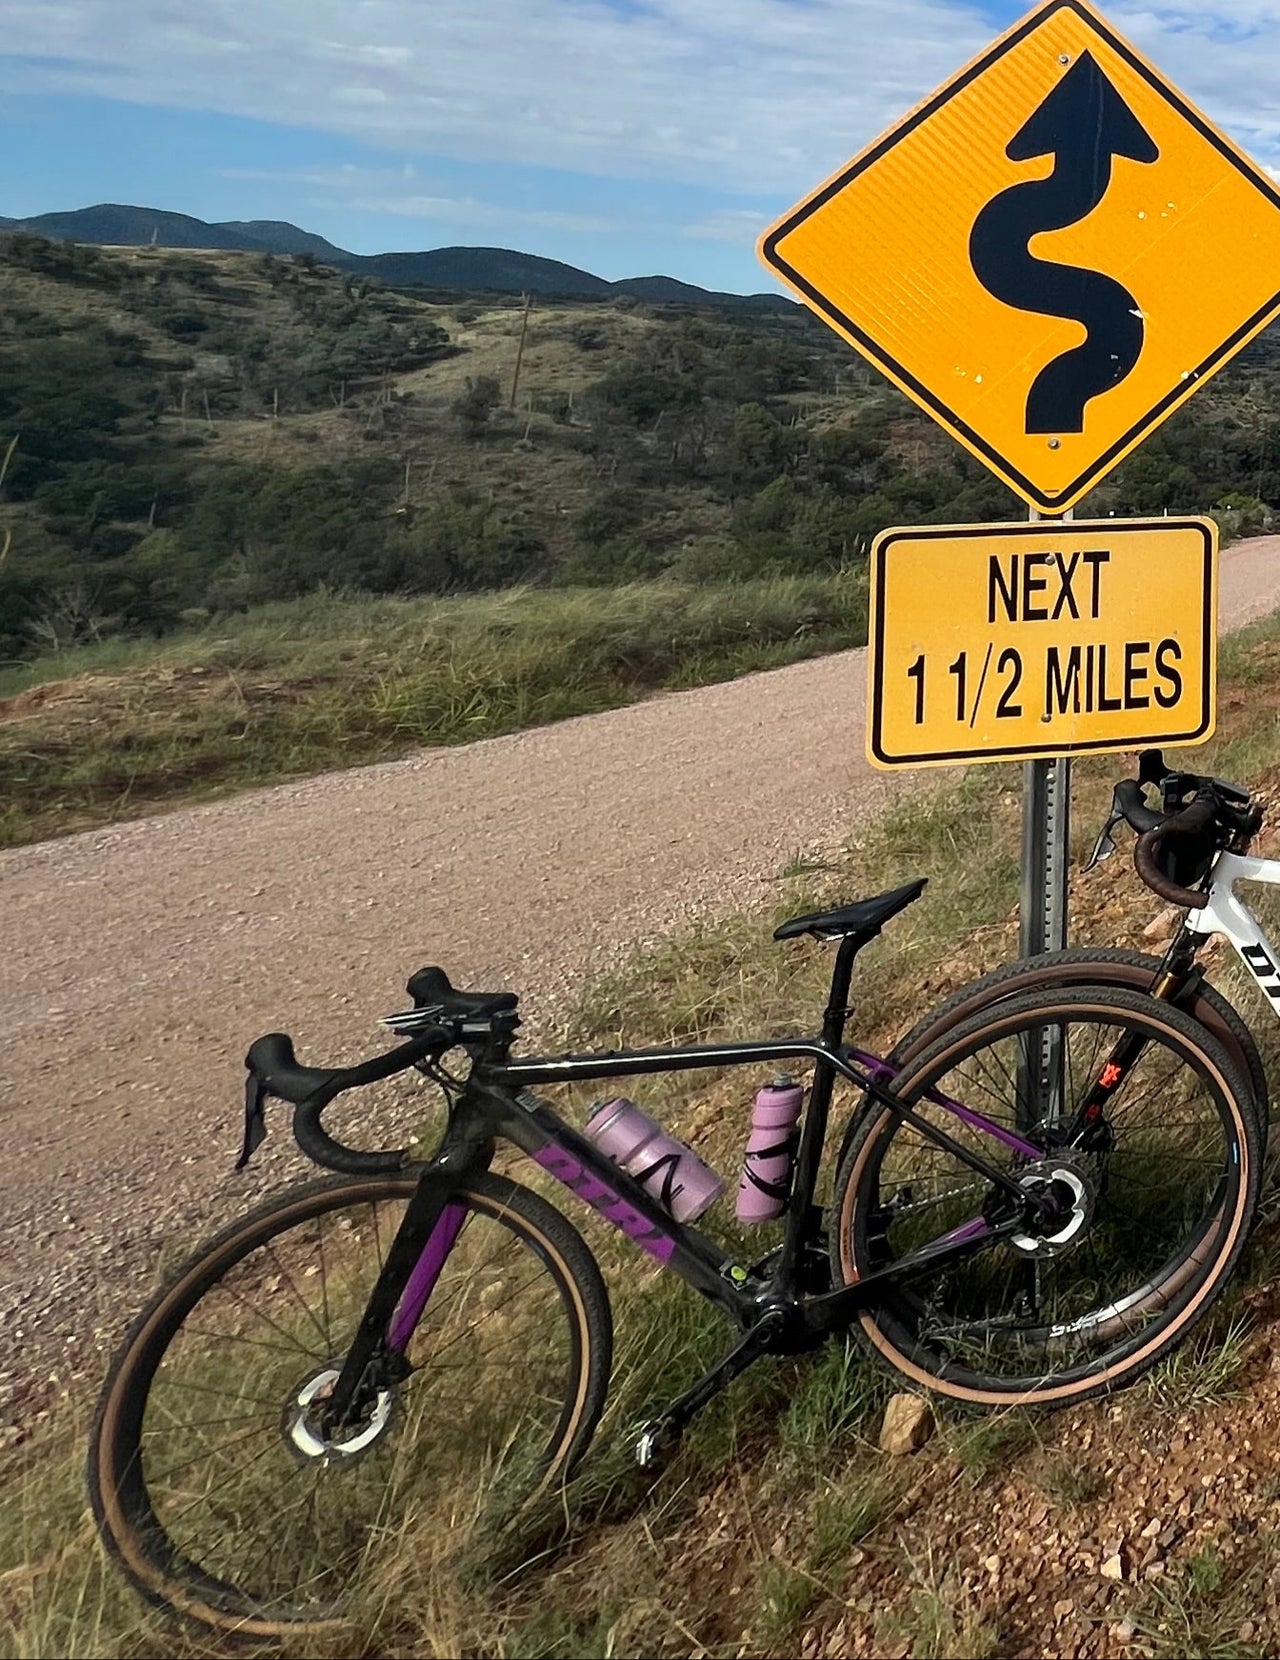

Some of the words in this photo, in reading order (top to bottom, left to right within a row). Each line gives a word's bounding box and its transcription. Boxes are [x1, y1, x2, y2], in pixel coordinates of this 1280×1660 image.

[988, 550, 1110, 624] NEXT
[907, 654, 925, 725] 1
[948, 642, 1023, 728] 1/2
[1045, 638, 1182, 715] MILES
